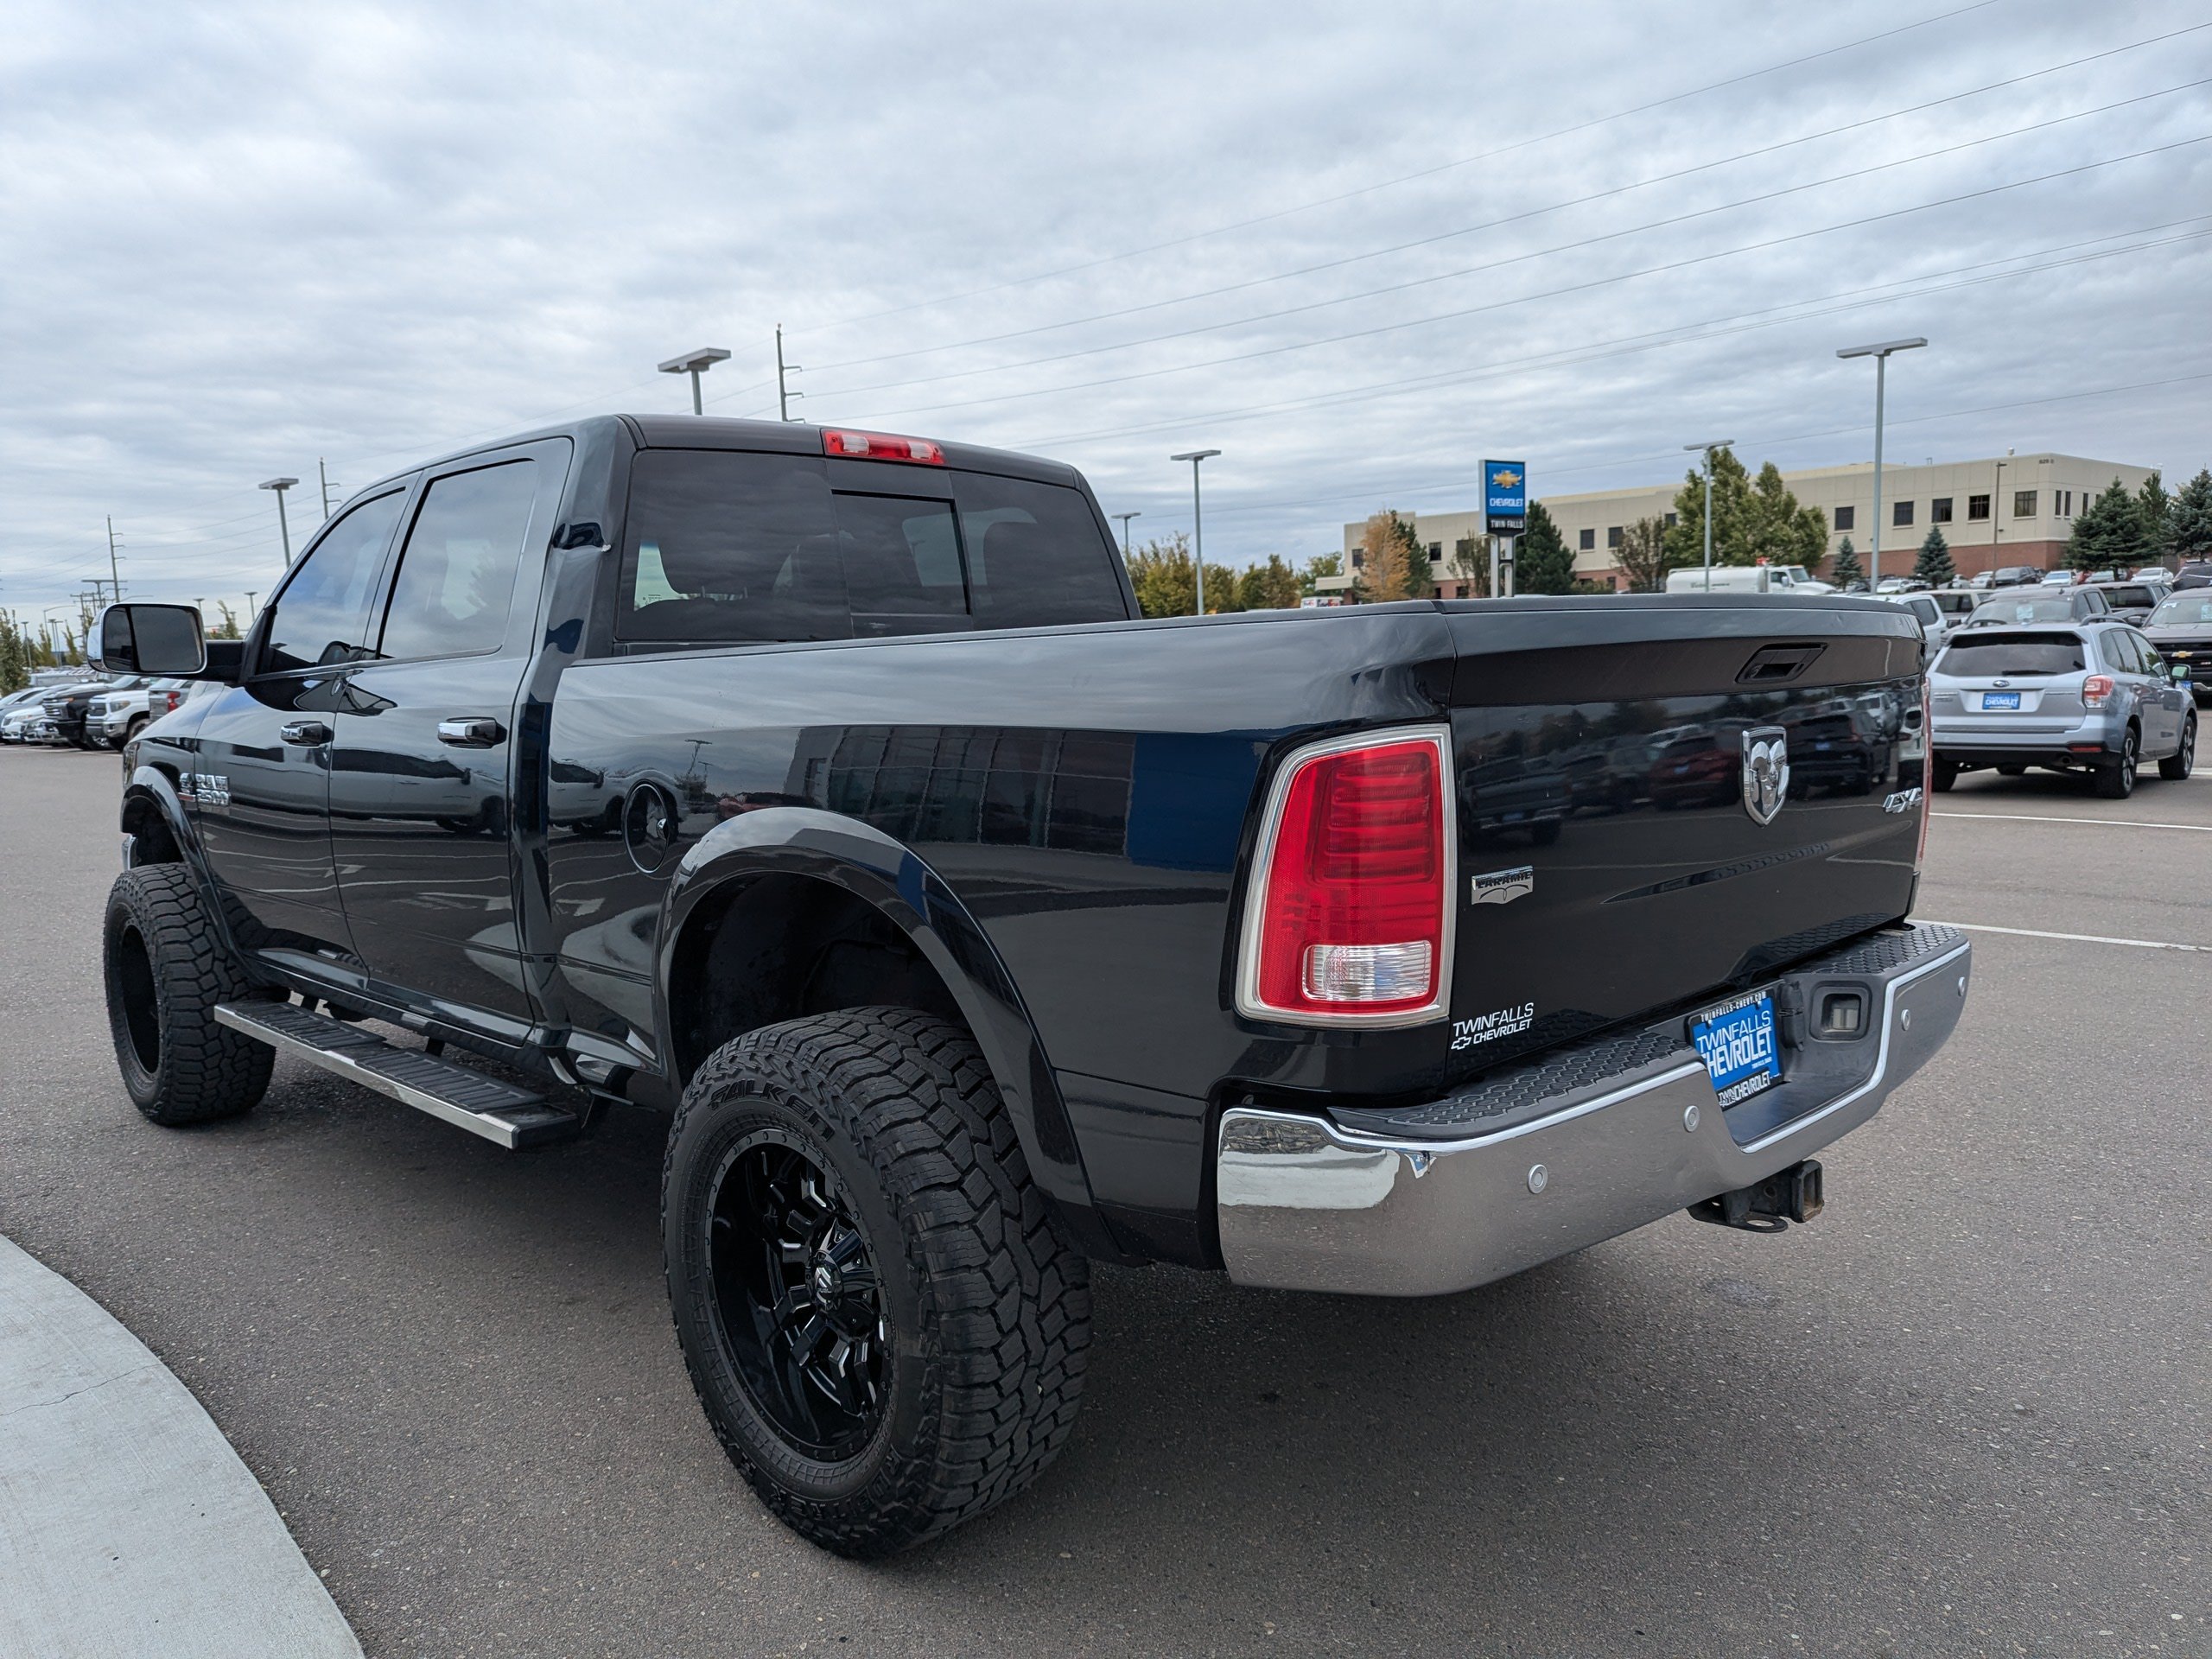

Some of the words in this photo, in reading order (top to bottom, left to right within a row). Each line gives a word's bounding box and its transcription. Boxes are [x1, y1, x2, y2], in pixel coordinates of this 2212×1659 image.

[1490, 498, 1523, 507] CHEVROLET
[1491, 519, 1505, 528] TWIN
[1507, 519, 1523, 529] FALLS
[1478, 870, 1533, 889] LARAMIE
[1453, 1002, 1534, 1037] TWINFALLS
[1473, 1019, 1533, 1044] CHEVROLET
[1697, 1010, 1770, 1053] TWINFALLS
[1734, 1071, 1770, 1101] CHEVROLET
[708, 1078, 836, 1142] FALKEN
